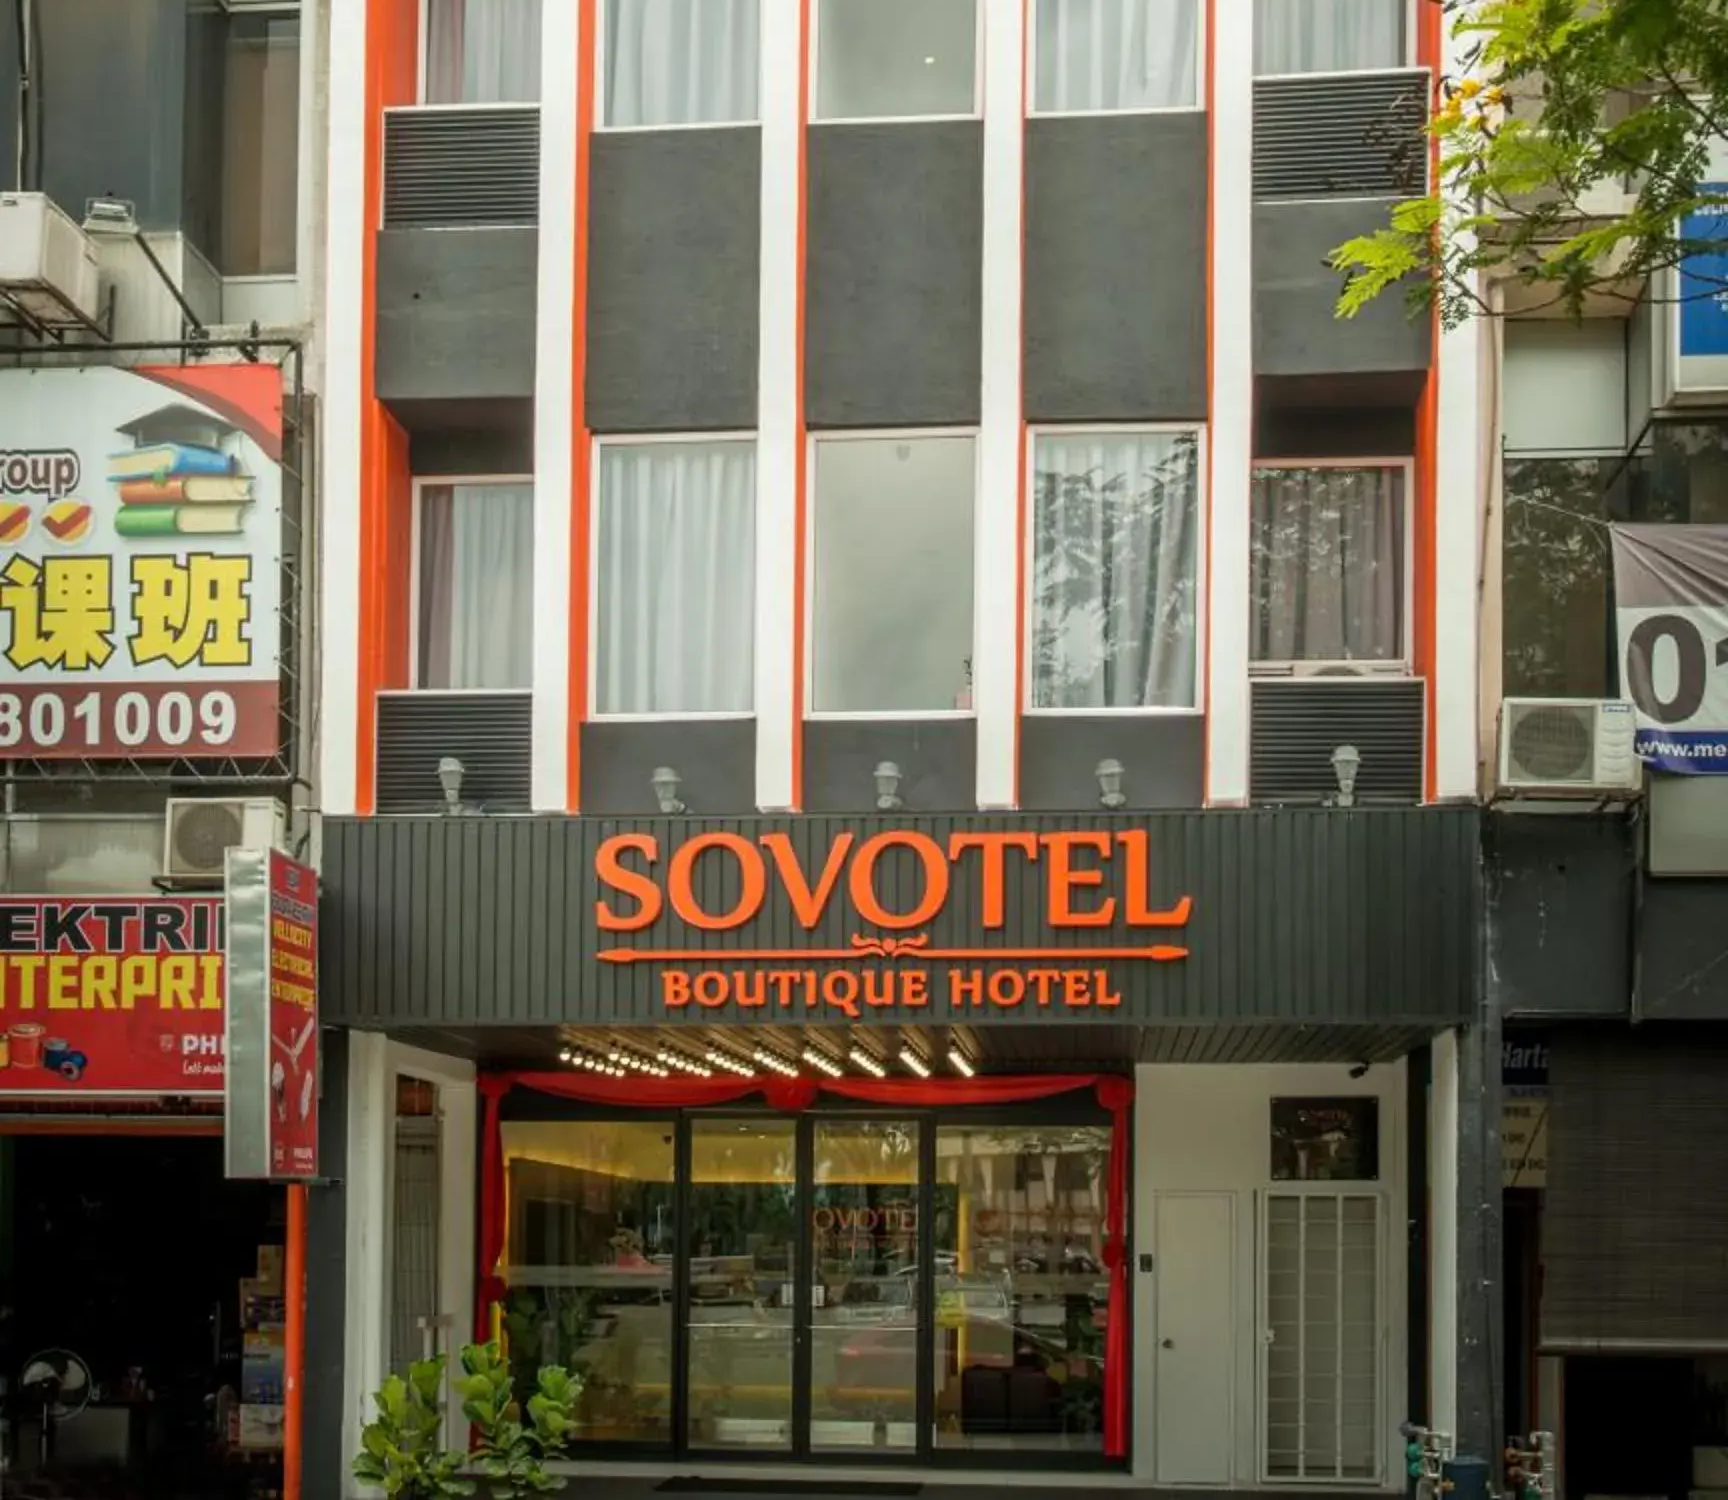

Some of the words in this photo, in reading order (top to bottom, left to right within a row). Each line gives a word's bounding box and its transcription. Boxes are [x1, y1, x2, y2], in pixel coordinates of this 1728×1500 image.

[1627, 614, 1728, 724] 0
[0, 691, 236, 747] 801009
[594, 828, 1192, 931] SOVOTEL
[0, 955, 223, 1009] TERPRI
[661, 968, 929, 1017] BOUTIQUE
[948, 968, 1121, 1006] HOTEL
